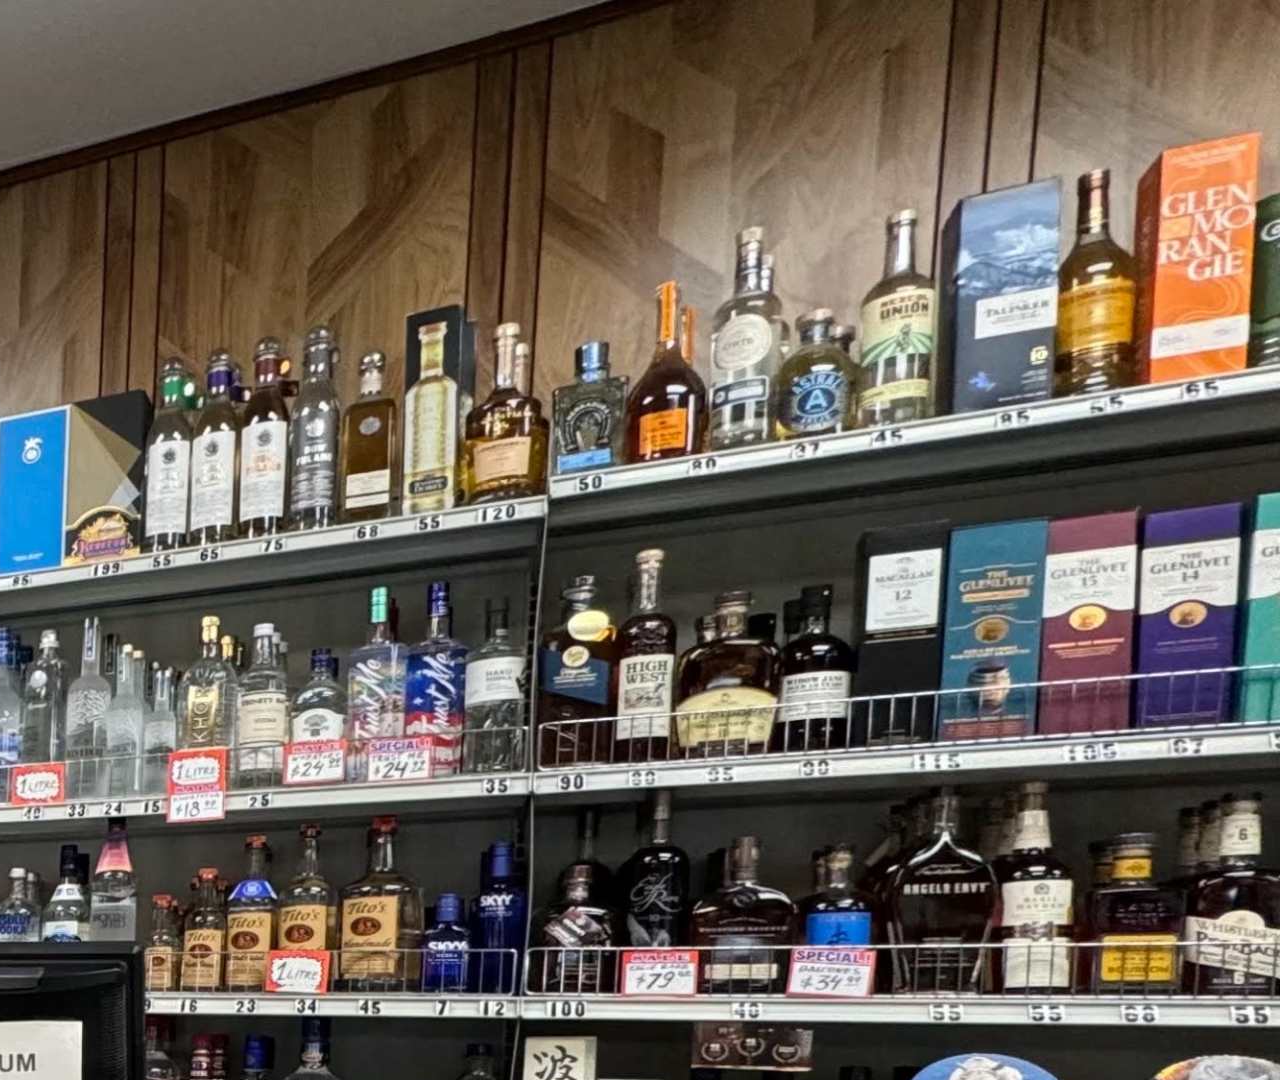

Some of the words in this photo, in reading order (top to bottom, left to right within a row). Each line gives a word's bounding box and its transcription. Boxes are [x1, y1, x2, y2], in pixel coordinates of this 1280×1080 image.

[1160, 181, 1255, 218] GLEN
[1191, 203, 1255, 236] MO
[1157, 231, 1232, 265] RAN
[1186, 250, 1244, 282] GIE
[880, 302, 930, 321] UNIÓN
[1185, 382, 1220, 398] 65
[1000, 411, 1030, 425] 85
[874, 428, 903, 443] 45
[795, 443, 820, 459] 37
[691, 458, 717, 473] 80
[579, 475, 603, 491] 50
[479, 504, 517, 521] 120
[418, 516, 441, 530] 55
[356, 524, 380, 539] 68
[263, 538, 284, 553] 75
[153, 554, 173, 568] 55
[200, 547, 220, 560] 65
[1179, 550, 1203, 561] THE
[93, 562, 121, 576] 199
[1077, 556, 1102, 568] THE
[1149, 555, 1232, 575] GLENLIVET
[985, 568, 1009, 580] THE
[1049, 562, 1128, 581] GLENLIVET
[1180, 569, 1200, 584] 14
[959, 574, 1036, 592] GLENLIVET
[1081, 575, 1099, 588] 15
[894, 588, 913, 601] 12
[625, 659, 669, 674] HIGH
[626, 671, 669, 685] WEST
[290, 759, 324, 779] $24
[374, 759, 409, 779] $24
[485, 779, 509, 793] 35
[559, 774, 585, 790] 90
[144, 800, 161, 813] 15
[249, 794, 271, 808] 25
[66, 803, 86, 817] 33
[104, 803, 123, 816] 24
[954, 881, 992, 895] ENVY
[346, 899, 386, 916] Tito's
[479, 893, 513, 907] SKYY
[228, 914, 265, 931] Tito's
[281, 908, 319, 926] Tito's
[186, 930, 217, 945] Tito's
[427, 939, 468, 952] SKYY
[795, 950, 871, 963] SPECIAL!
[287, 966, 321, 982] LITRE
[180, 999, 198, 1013] 16
[234, 999, 256, 1013] 23
[297, 999, 318, 1014] 34
[359, 1000, 381, 1015] 45
[437, 1001, 447, 1015] 7
[483, 1002, 505, 1017] 12
[549, 1000, 586, 1018] 100
